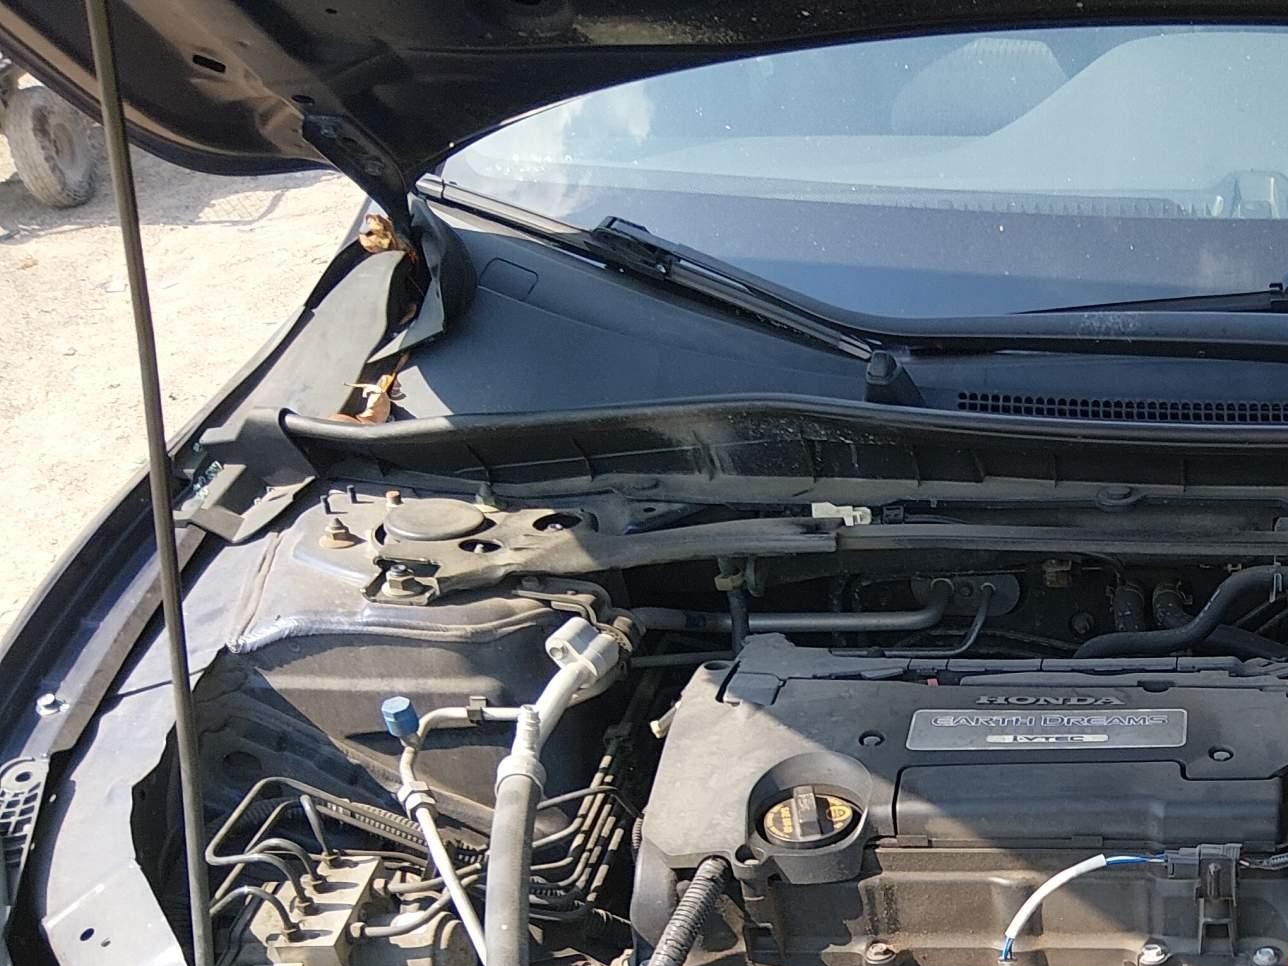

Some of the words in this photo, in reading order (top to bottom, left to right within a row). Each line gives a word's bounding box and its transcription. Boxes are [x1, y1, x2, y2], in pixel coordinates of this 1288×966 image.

[976, 695, 1125, 706] HONDA
[931, 715, 1035, 728] EARTH
[1041, 715, 1169, 727] DREAMS
